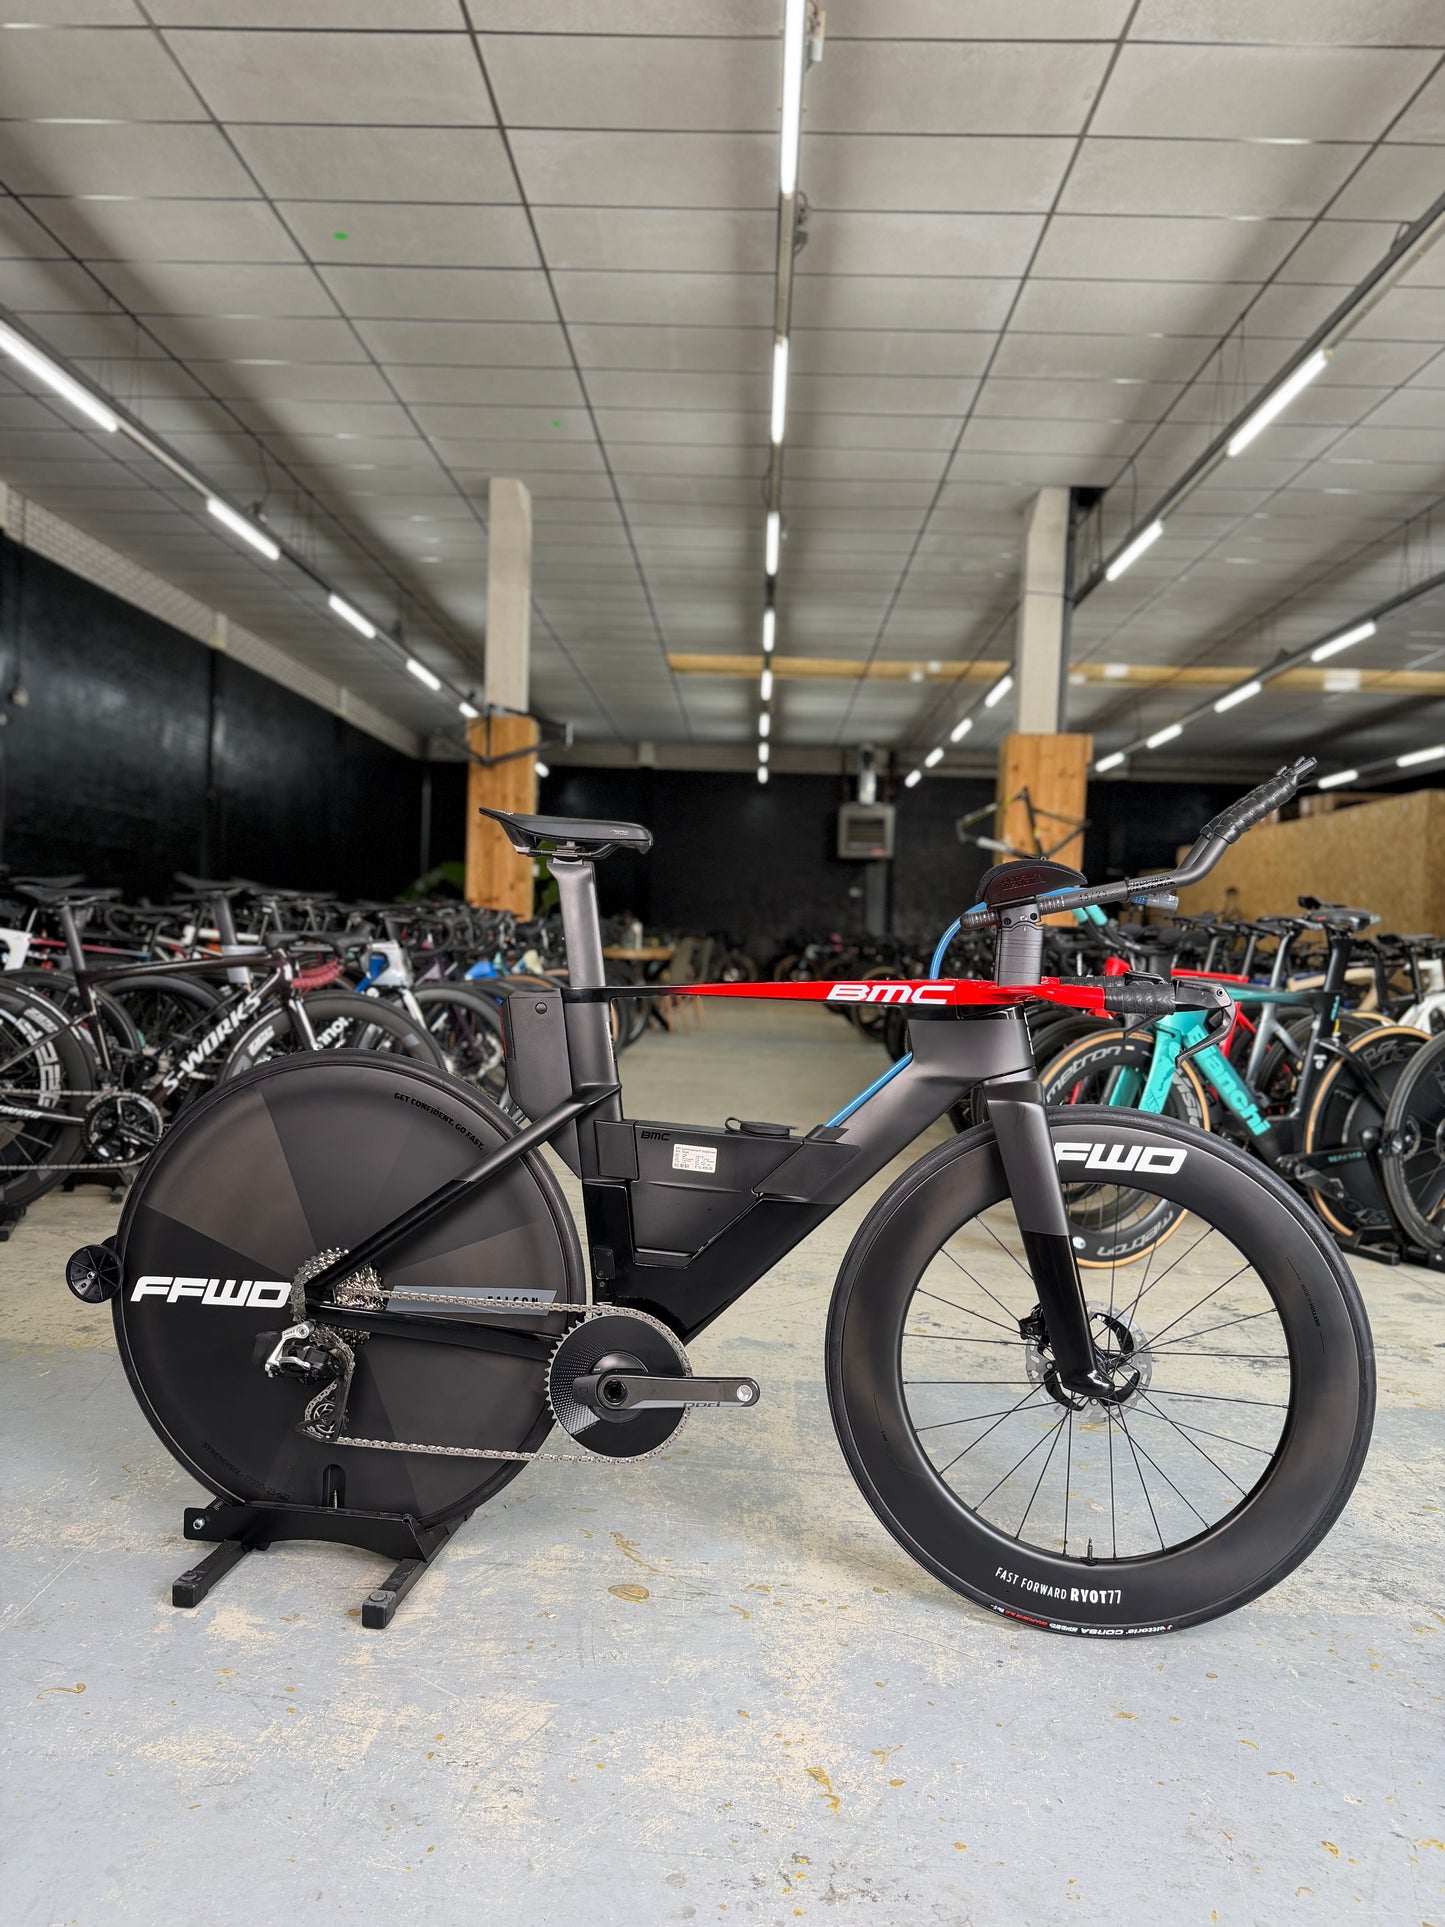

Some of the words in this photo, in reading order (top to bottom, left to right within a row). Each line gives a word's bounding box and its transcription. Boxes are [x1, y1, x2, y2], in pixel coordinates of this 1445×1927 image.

[826, 984, 955, 1005] BMC
[163, 995, 261, 1096] S-WORKS
[1046, 1044, 1122, 1103] metron
[394, 1092, 410, 1103] GET
[411, 1098, 454, 1126] CONFIDENT.
[455, 1123, 466, 1134] GO
[466, 1131, 484, 1150] FAST.
[640, 1131, 671, 1141] BMC
[1053, 1142, 1188, 1175] FWD
[130, 1276, 292, 1309] FFWD
[994, 1567, 1020, 1585] FAST
[1020, 1578, 1067, 1600] FORWARD
[1070, 1587, 1122, 1605] RYOT77
[1081, 1627, 1123, 1636] CORSA
